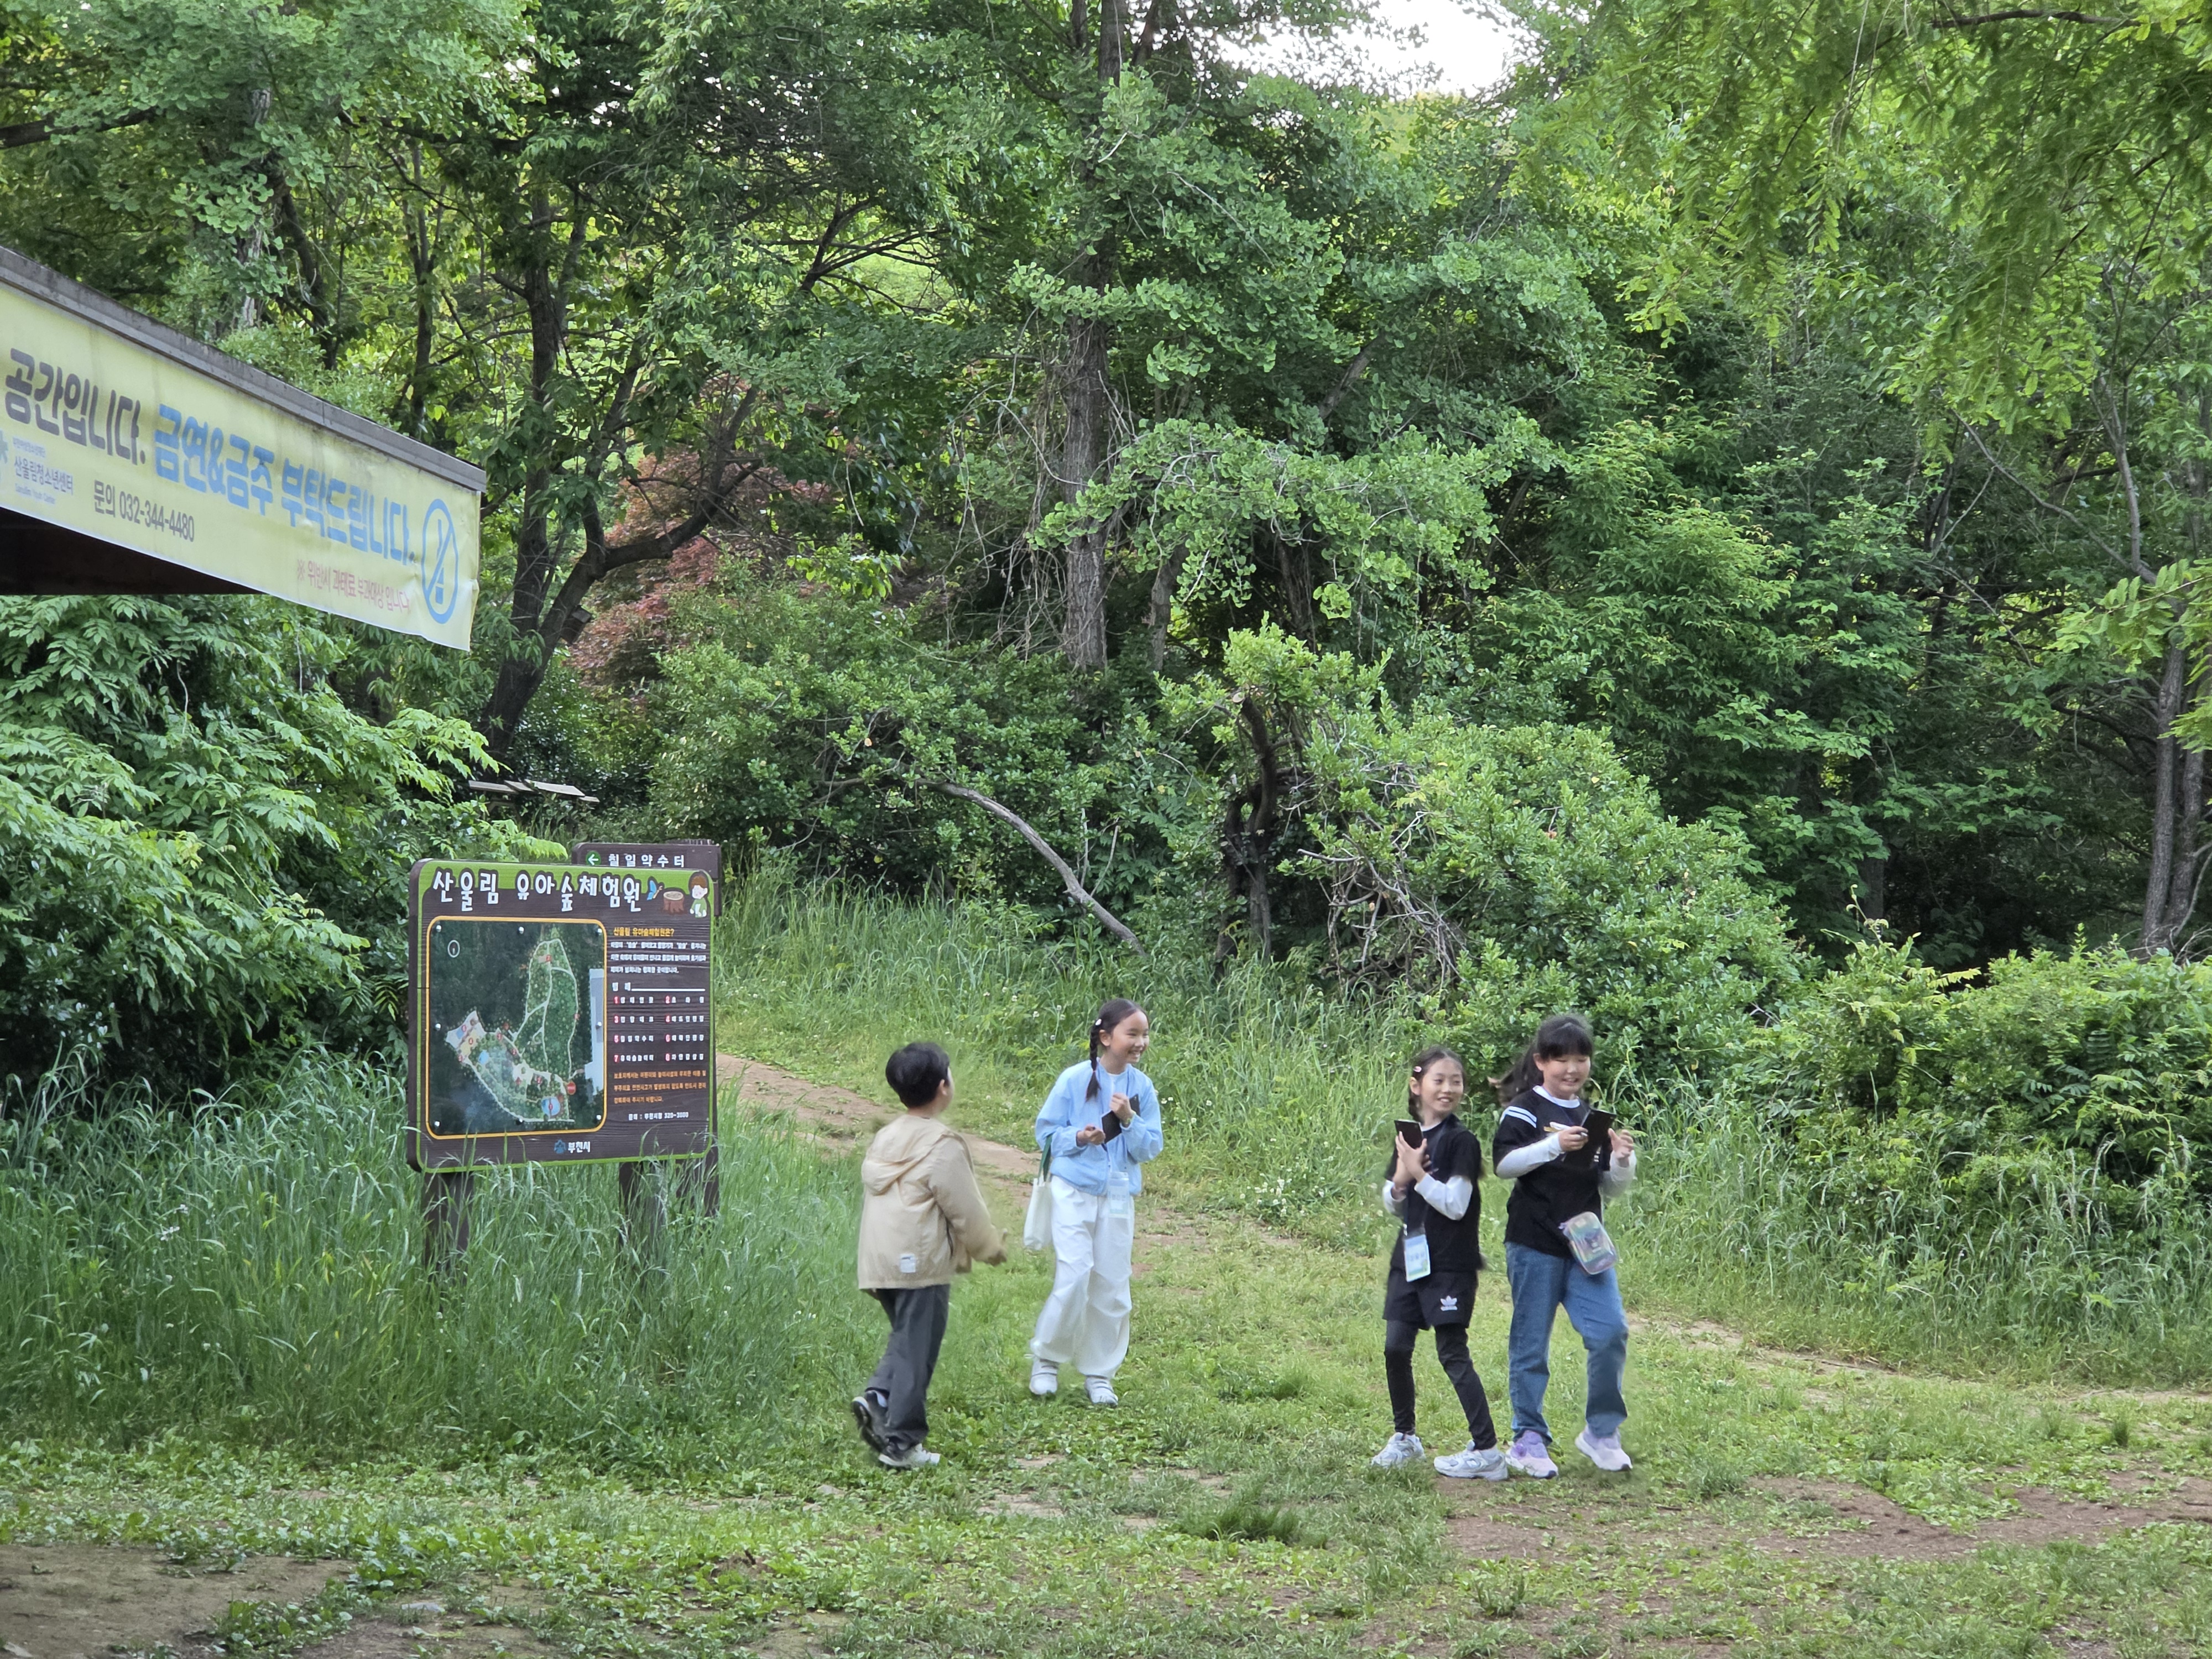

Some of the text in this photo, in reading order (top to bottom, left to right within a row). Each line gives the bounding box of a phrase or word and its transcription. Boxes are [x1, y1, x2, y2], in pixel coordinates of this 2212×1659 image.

[5, 348, 415, 566] 공간입니다. 금연&금주 부탁드립니다.
[14, 455, 74, 495] 산울림청소년센터
[94, 479, 116, 518] 문의
[119, 491, 195, 542] 032-344-4480
[333, 569, 356, 598] 과태료
[608, 853, 685, 868] 칠일약수터
[432, 869, 641, 912] 산울림 유아숲체험원
[568, 1141, 591, 1154] 부천시
